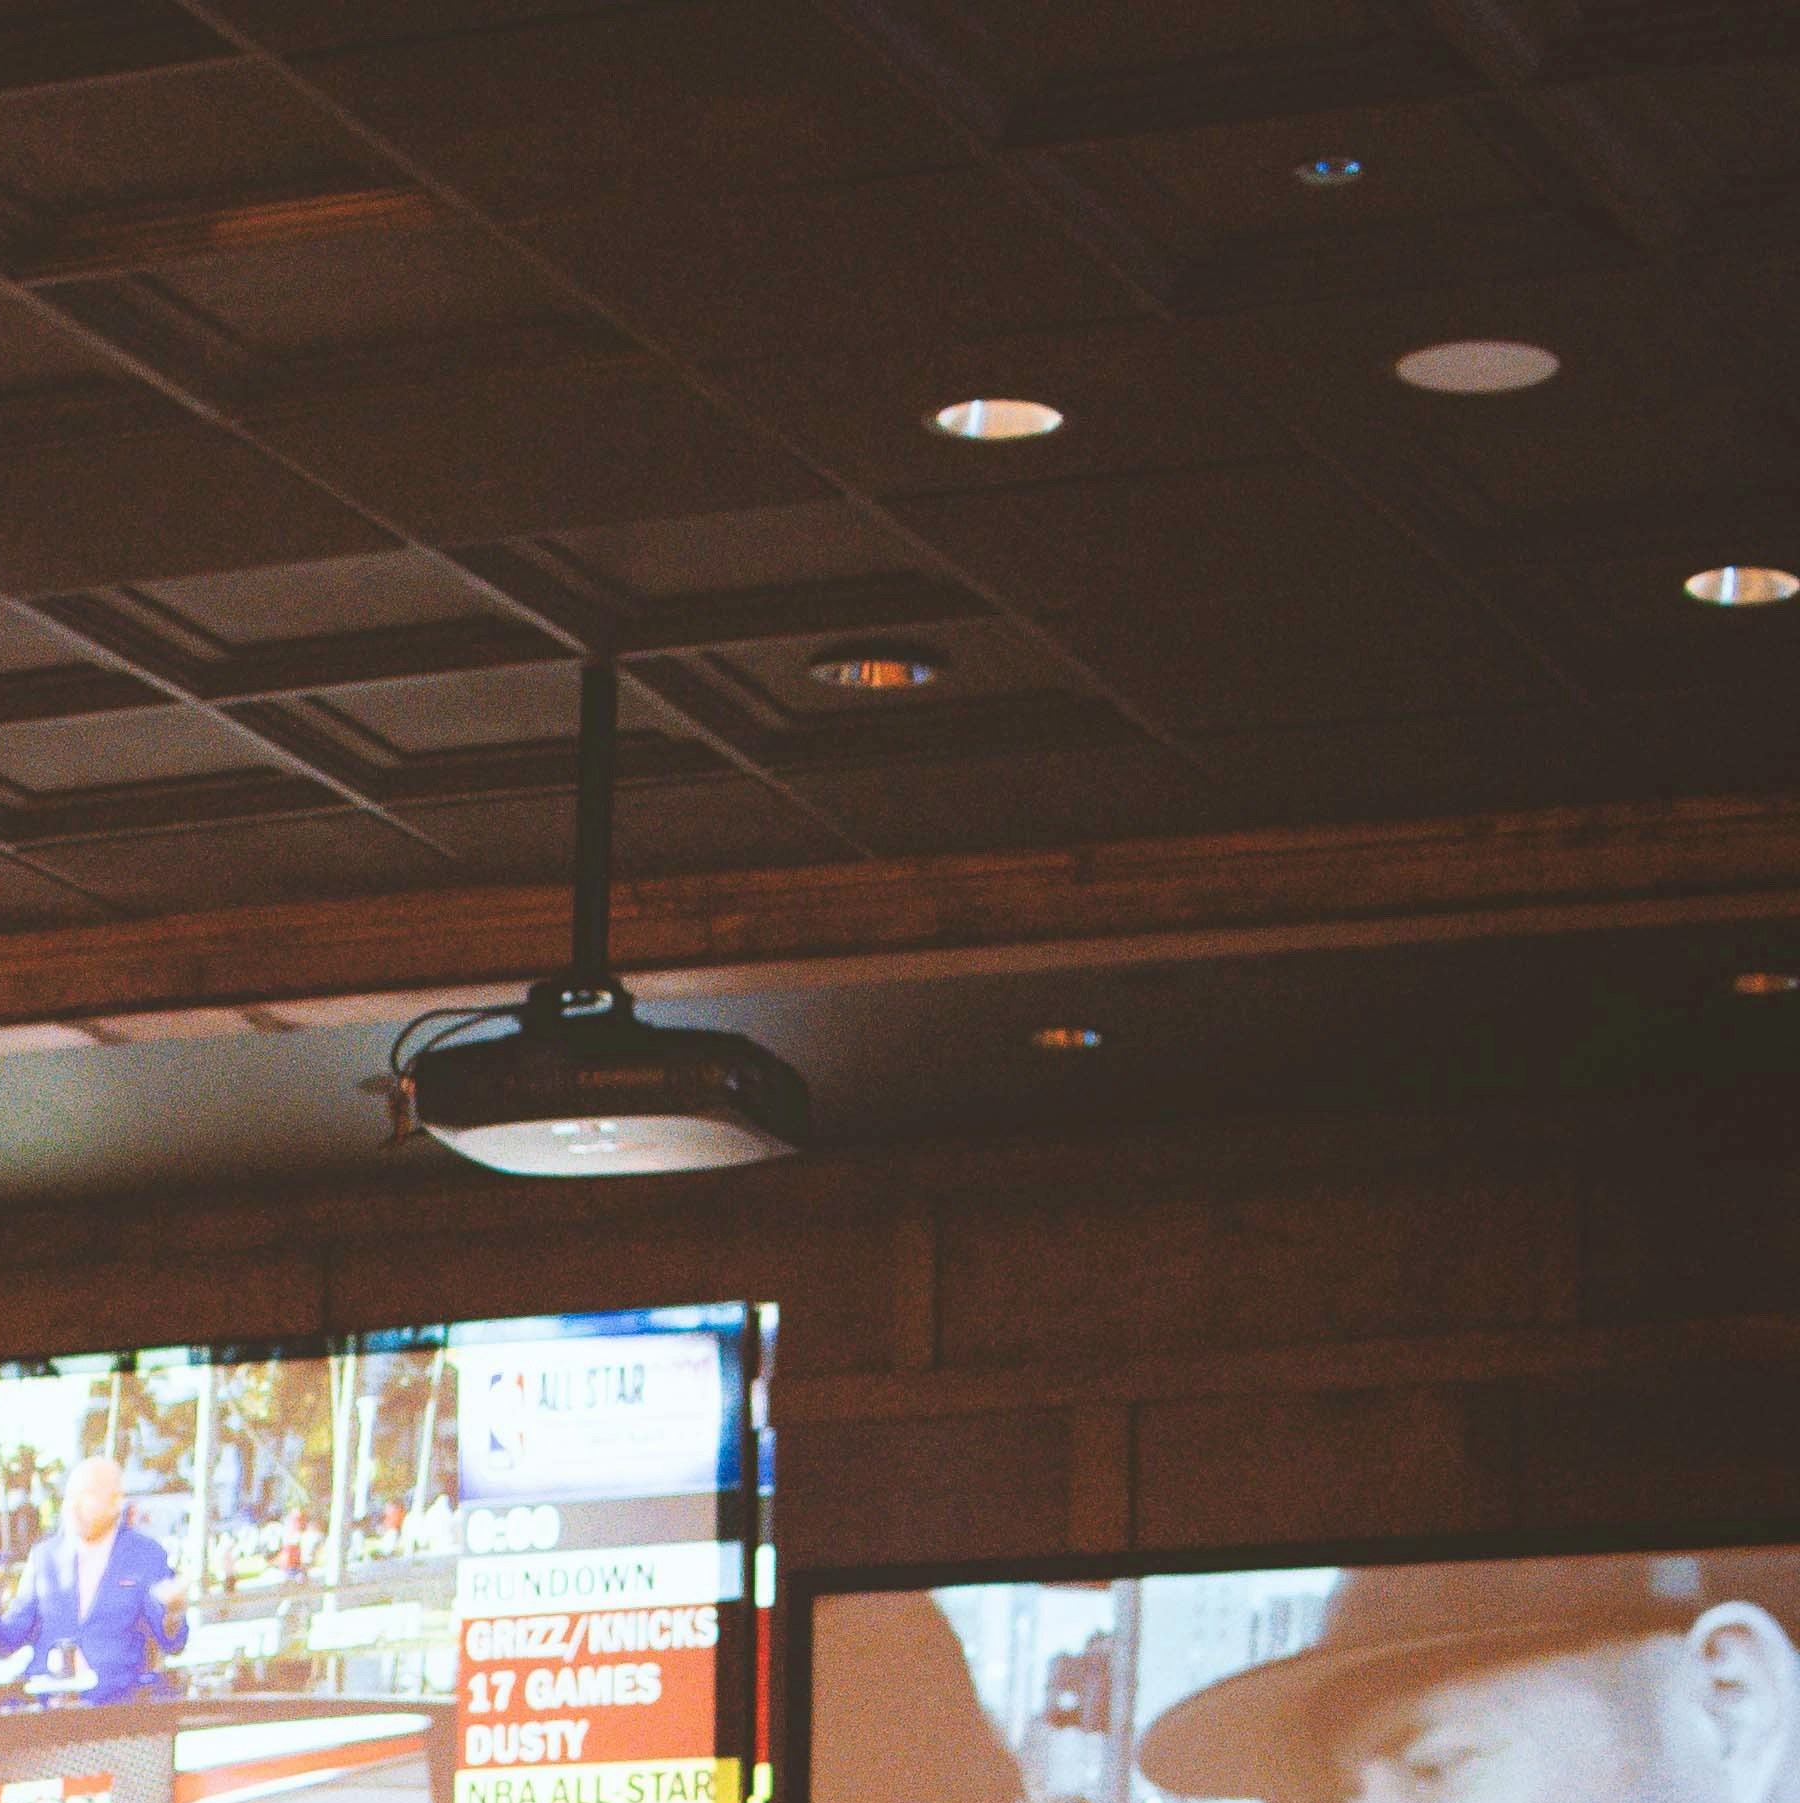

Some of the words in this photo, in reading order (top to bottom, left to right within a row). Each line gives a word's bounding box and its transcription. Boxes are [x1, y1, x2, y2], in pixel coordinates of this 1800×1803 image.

[586, 1365, 647, 1408] STAR
[472, 1562, 656, 1602] RUNDOWN
[466, 1609, 719, 1661] GRIZZ/KNICKS
[469, 1672, 514, 1711] 17
[526, 1665, 661, 1708] GAMES
[466, 1721, 588, 1764] DUSTY
